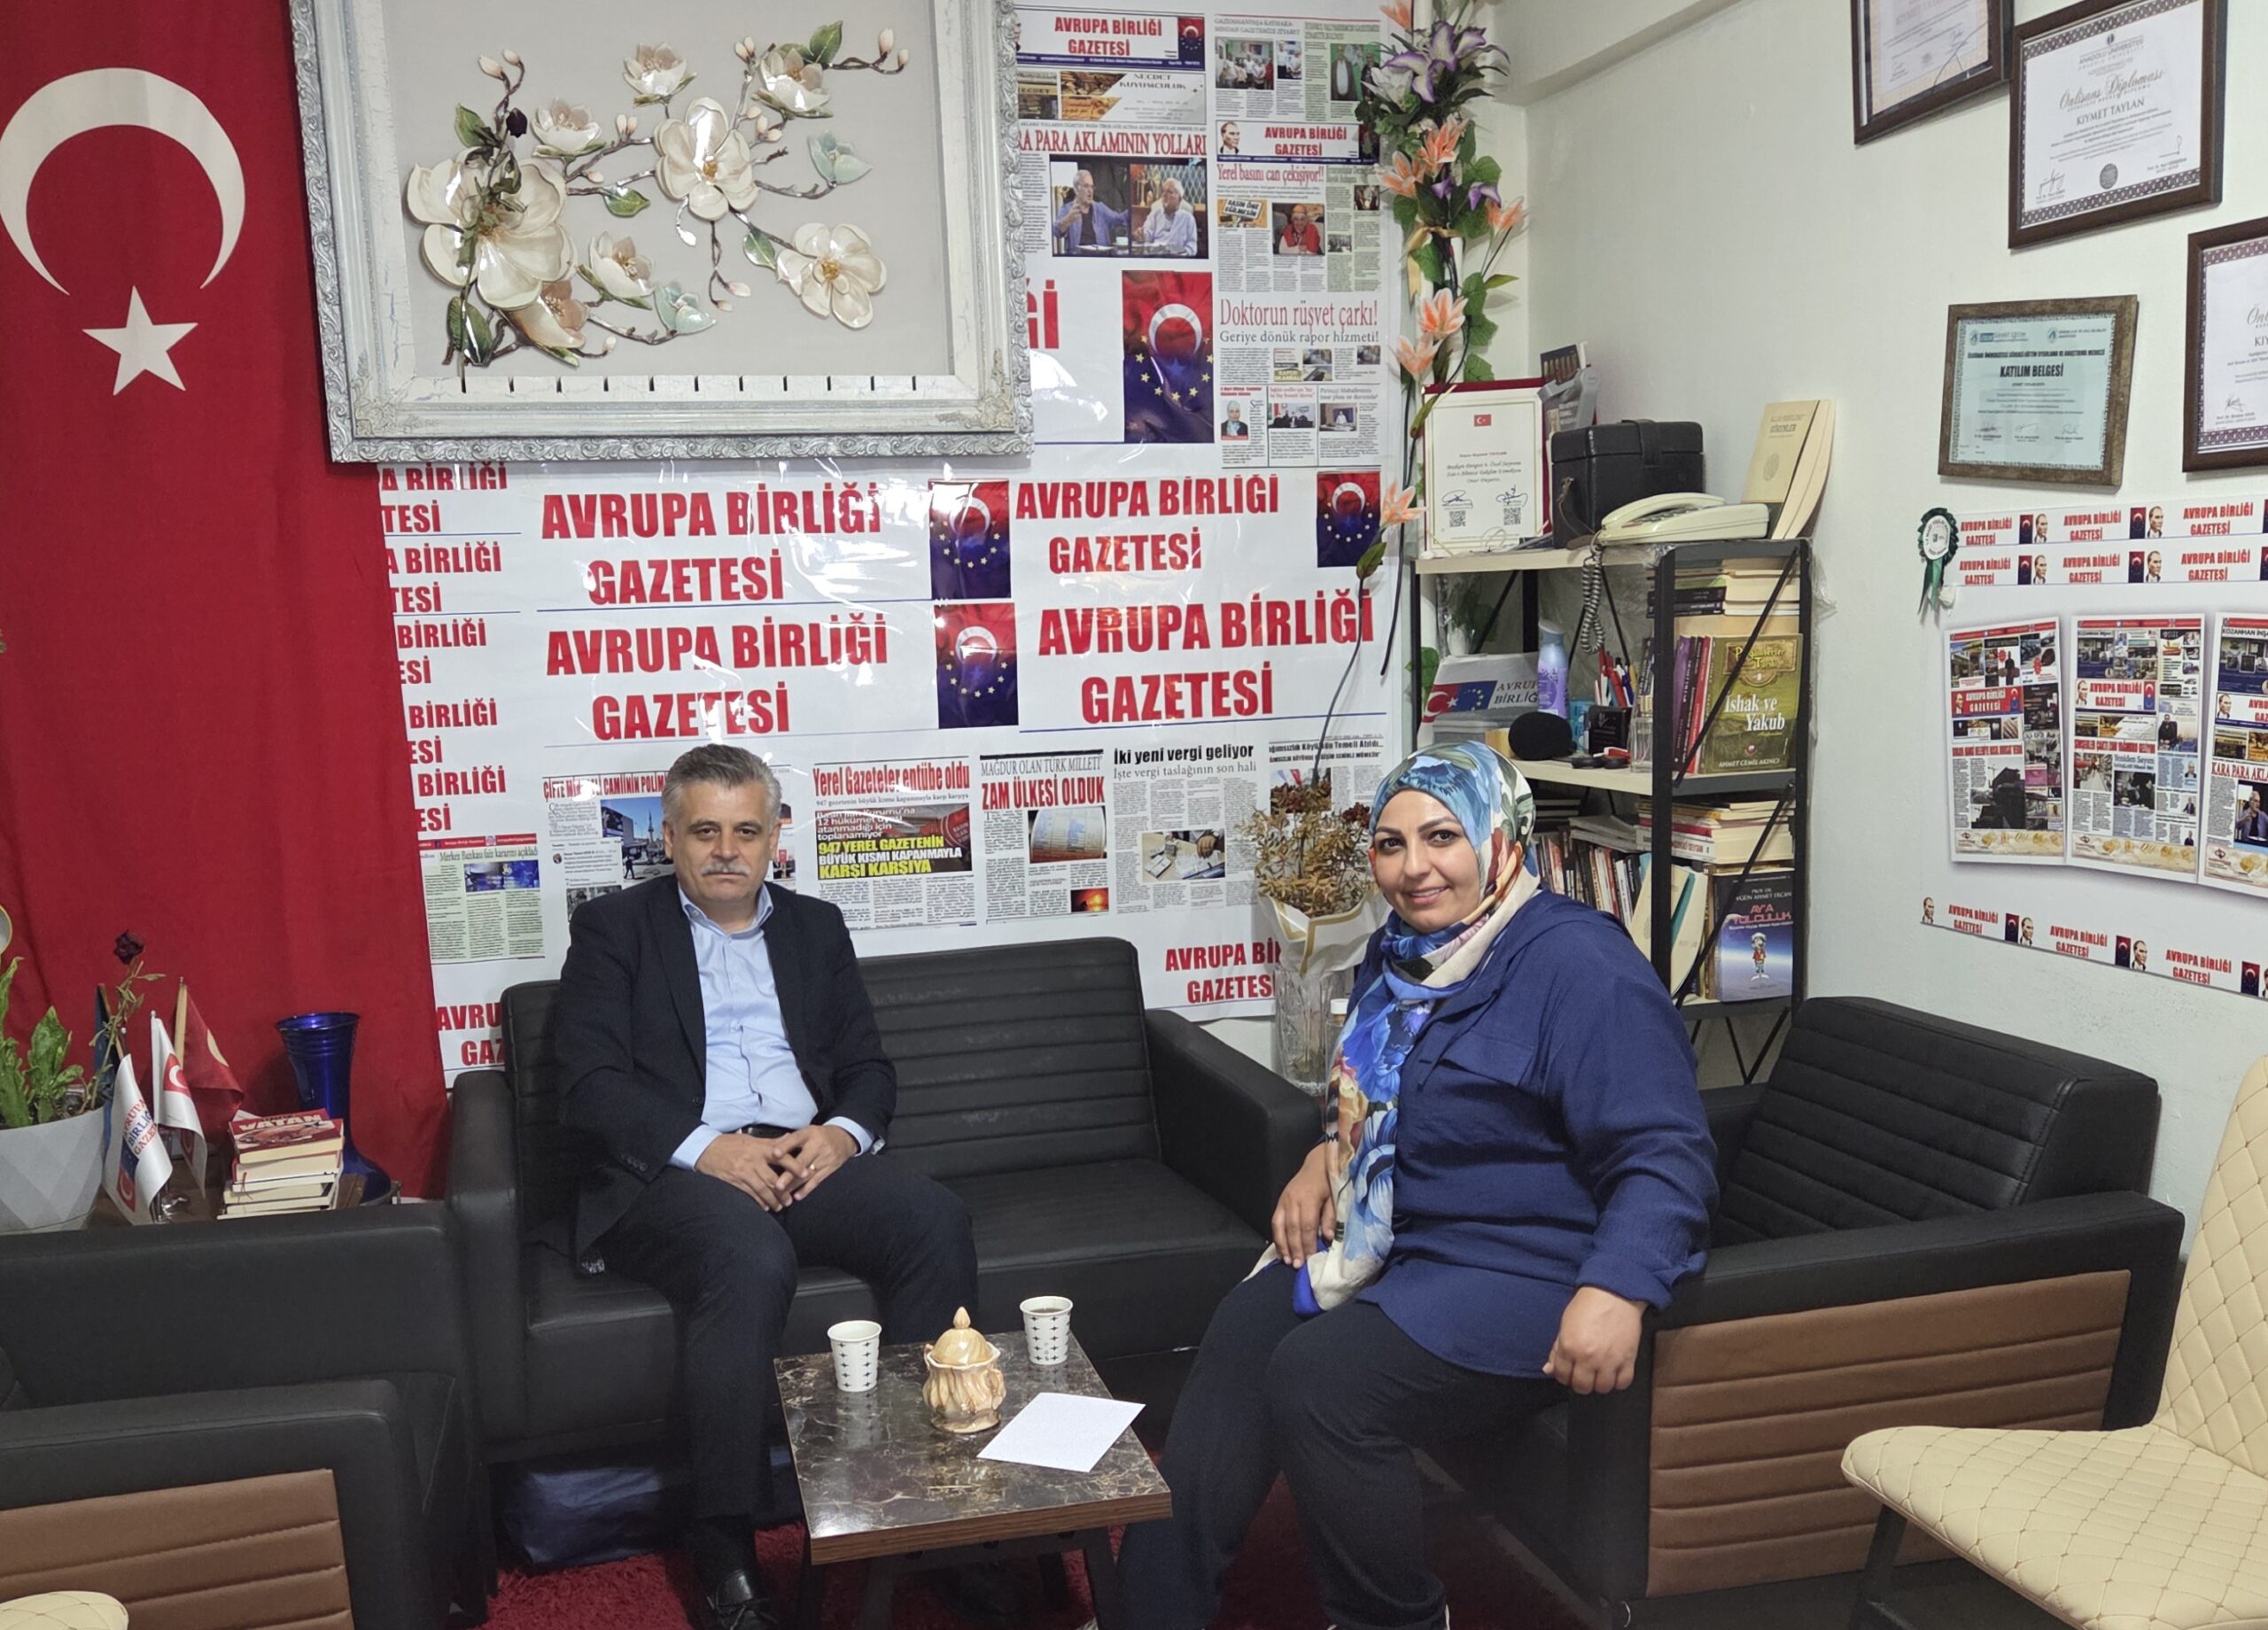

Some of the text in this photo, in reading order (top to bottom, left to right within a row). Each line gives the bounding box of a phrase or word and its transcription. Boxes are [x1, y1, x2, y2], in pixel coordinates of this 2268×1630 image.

[1054, 16, 1162, 36] AVRUPA BİRLİĞİ
[1068, 39, 1130, 56] GAZETESİ
[2077, 97, 2145, 126] KIYMET TAYLAN
[1035, 129, 1207, 156] PARA AKLAMININ YOLLARI
[1264, 126, 1347, 140] AVRUPA BİRLİĞİ
[1274, 143, 1322, 156] GAZETESİ
[1216, 164, 1237, 181] Yerel
[1266, 170, 1281, 182] can
[1220, 298, 1379, 334] Doktorun rüşvet çarkı!
[1219, 330, 1379, 345] Geriye dönük rapor hizmeti!
[2000, 361, 2064, 378] KATILIM BELGESİ
[1015, 473, 1279, 520] AVRUPA BİRLİĞİ
[541, 481, 882, 540] AVRUPA BİRLİĞİ
[2063, 515, 2093, 526] AVRUPA
[2183, 502, 2254, 520] AVRUPA BİRLİĞİ
[2070, 527, 2103, 541] GAZETESİ
[2190, 521, 2231, 536] GAZETESİ
[404, 540, 502, 574] BİRLİĞİ
[1048, 526, 1202, 575] GAZETESİ
[2181, 549, 2251, 565] AVRUPA BİRLİĞİ
[2062, 557, 2092, 568] AVRUPA
[587, 548, 785, 606] GAZETESİ
[2069, 570, 2102, 583] GAZETESİ
[2188, 567, 2229, 581] GAZETESİ
[1037, 588, 1374, 656] AVRUPA BİRLİĞİ
[396, 617, 487, 648] BİRLİĞİ
[547, 612, 888, 676] AVRUPA BİRLİĞİ
[1081, 662, 1273, 725] GAZETESİ
[1724, 691, 1777, 712] İshak ve
[408, 697, 498, 729] BİRLİĞİ
[592, 681, 790, 741] GAZETESİ
[1745, 713, 1785, 732] Yakub
[1114, 742, 1254, 765] İki yeni vergi geliyor
[981, 757, 1018, 777] MAĞDUR
[1019, 758, 1042, 774] OLAN
[1113, 761, 1256, 780] İşte vergi taslağının son hali
[417, 765, 507, 796] BİRLİĞİ
[812, 766, 843, 796] Yerel
[845, 764, 900, 796] Gazeteler
[944, 760, 970, 790] oldu
[982, 773, 1106, 811] ZAM ÜLKESİ OLDUK
[818, 842, 842, 855] 947
[843, 839, 879, 852] YEREL
[880, 834, 944, 850] GAZETENİN
[819, 847, 963, 865] BÜYÜK KISMI KAPANMAYLA
[819, 859, 932, 879] KARŞI KARŞIYA
[1948, 904, 1974, 919] AVRUPA
[1953, 919, 1983, 935] GAZETESİ
[2049, 925, 2108, 947] AVRUPA BİRLİĞİ
[1165, 943, 1247, 972] AVRUPA
[2055, 941, 2089, 958] GAZETESİ
[2165, 950, 2232, 974] AVRUPA BİRLİĞİ
[2172, 966, 2210, 985] GAZETESİ
[238, 1114, 322, 1131] VATAN
